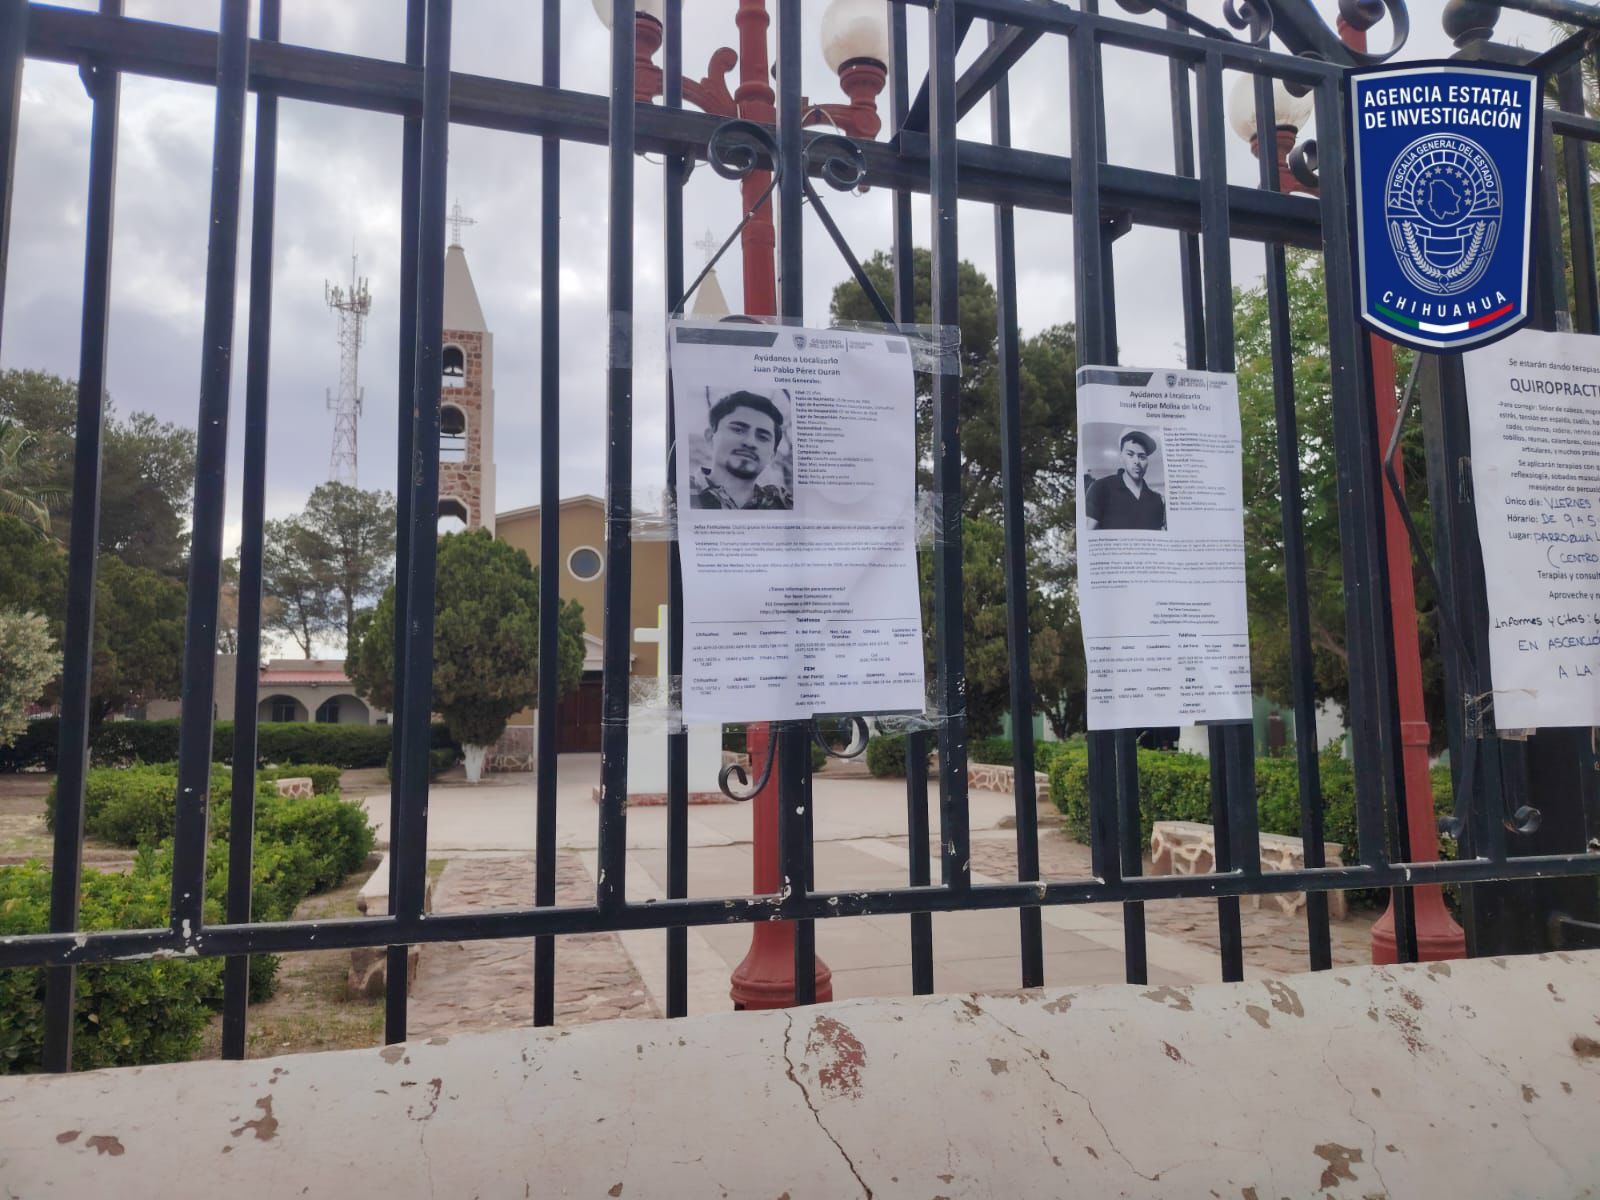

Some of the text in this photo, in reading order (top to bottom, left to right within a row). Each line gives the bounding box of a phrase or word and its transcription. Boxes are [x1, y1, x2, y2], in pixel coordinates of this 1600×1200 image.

[754, 354, 791, 363] Ayúdanos
[773, 366, 795, 374] Pablo
[1508, 358, 1518, 367] Se
[1519, 359, 1547, 369] estarán
[1549, 362, 1571, 372] dando
[1129, 391, 1162, 399] Ayúdanos
[1138, 402, 1158, 410] Felipe
[1518, 459, 1526, 467] Se
[1544, 497, 1592, 510] VIERNES
[1541, 513, 1557, 525] DE
[1563, 513, 1575, 529] 9
[1508, 531, 1533, 541] Lugar:
[1537, 570, 1567, 580] Terapias
[1549, 590, 1588, 600] Aproveche
[1495, 616, 1543, 629] Informes
[1518, 639, 1539, 651] EN
[1558, 664, 1593, 679] A LA
